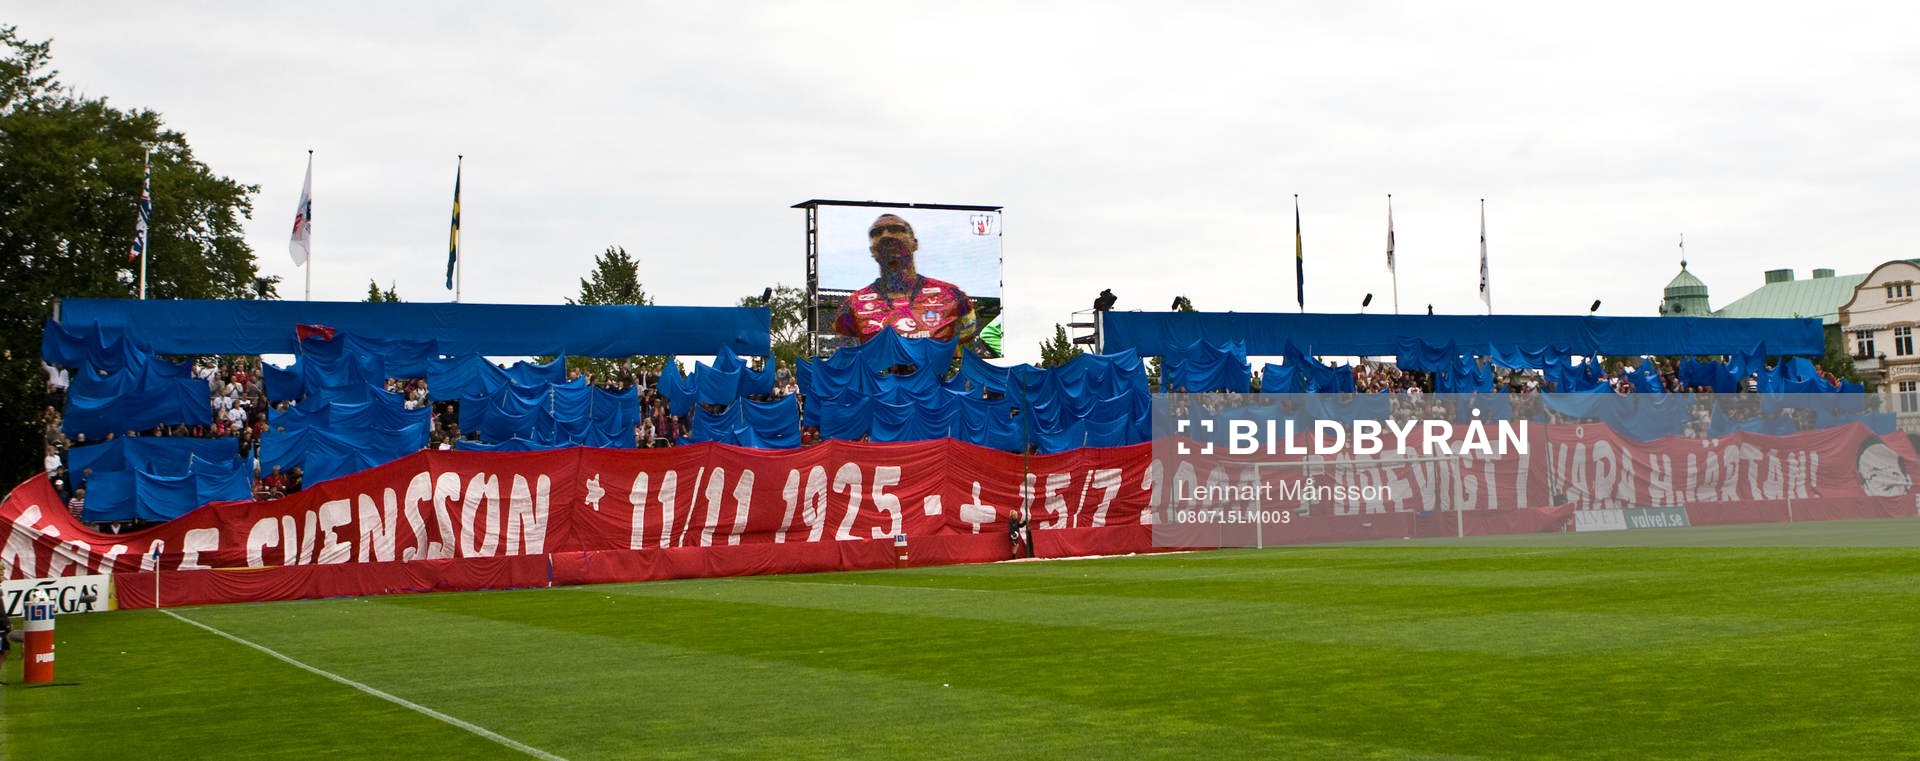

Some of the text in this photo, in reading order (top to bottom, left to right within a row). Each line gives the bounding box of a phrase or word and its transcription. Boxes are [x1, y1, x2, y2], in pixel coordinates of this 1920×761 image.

[246, 471, 551, 567] SVENSSON
[629, 466, 755, 550] 11/11
[775, 462, 902, 543] 1925
[1019, 469, 1122, 544] 15/7
[1546, 425, 1638, 511] VÅRA
[1631, 508, 1683, 528] valvet.se
